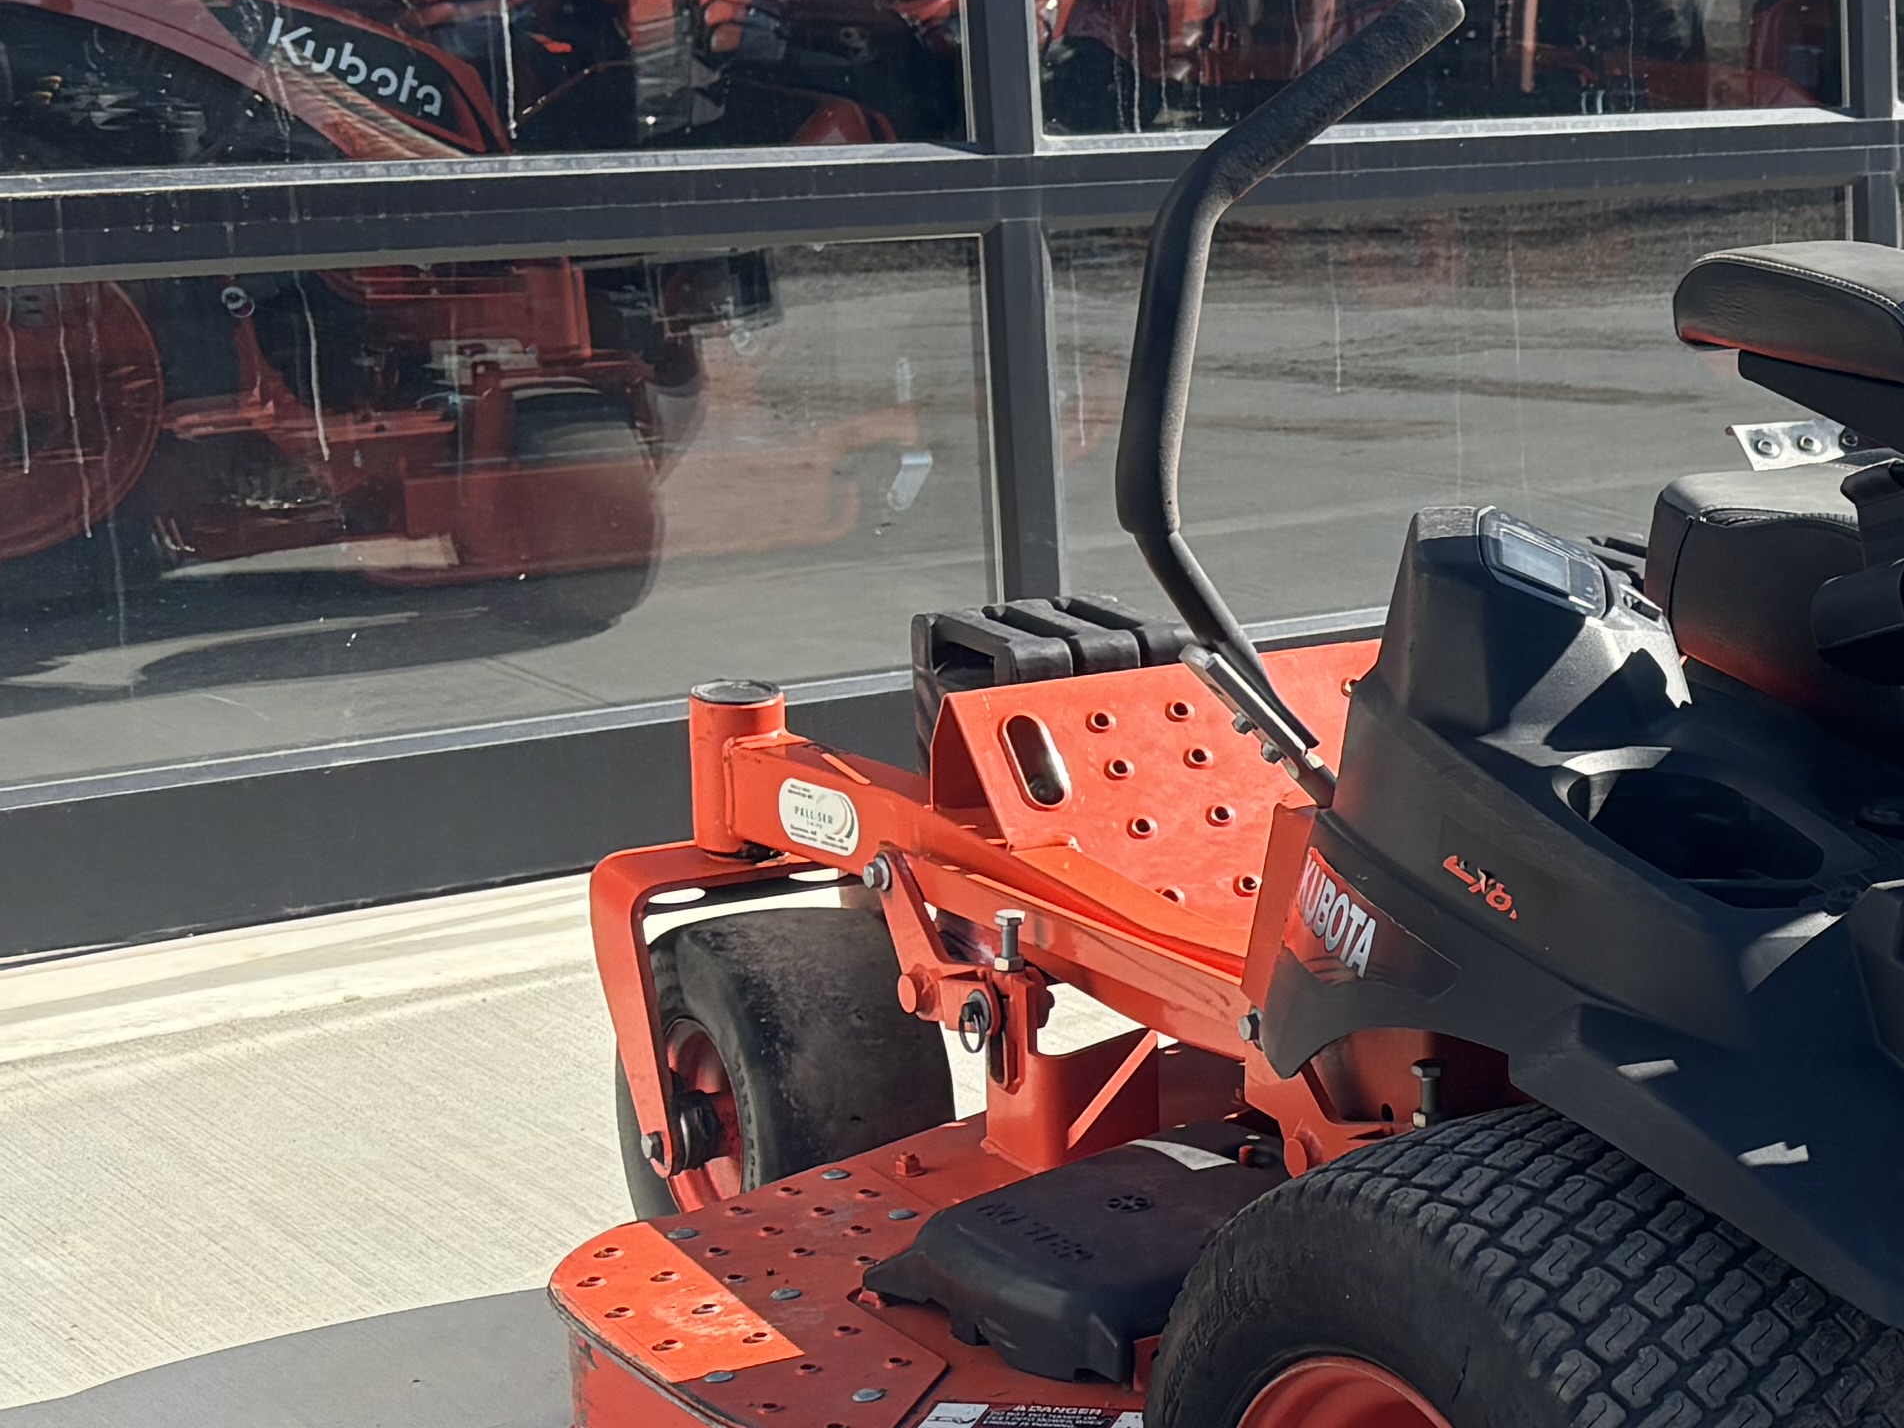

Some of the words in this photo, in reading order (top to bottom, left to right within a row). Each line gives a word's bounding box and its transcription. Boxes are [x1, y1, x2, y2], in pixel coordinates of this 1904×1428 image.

[268, 17, 442, 116] Kubota
[1297, 854, 1376, 978] KUBOTA
[1025, 1404, 1102, 1416] DANGER
